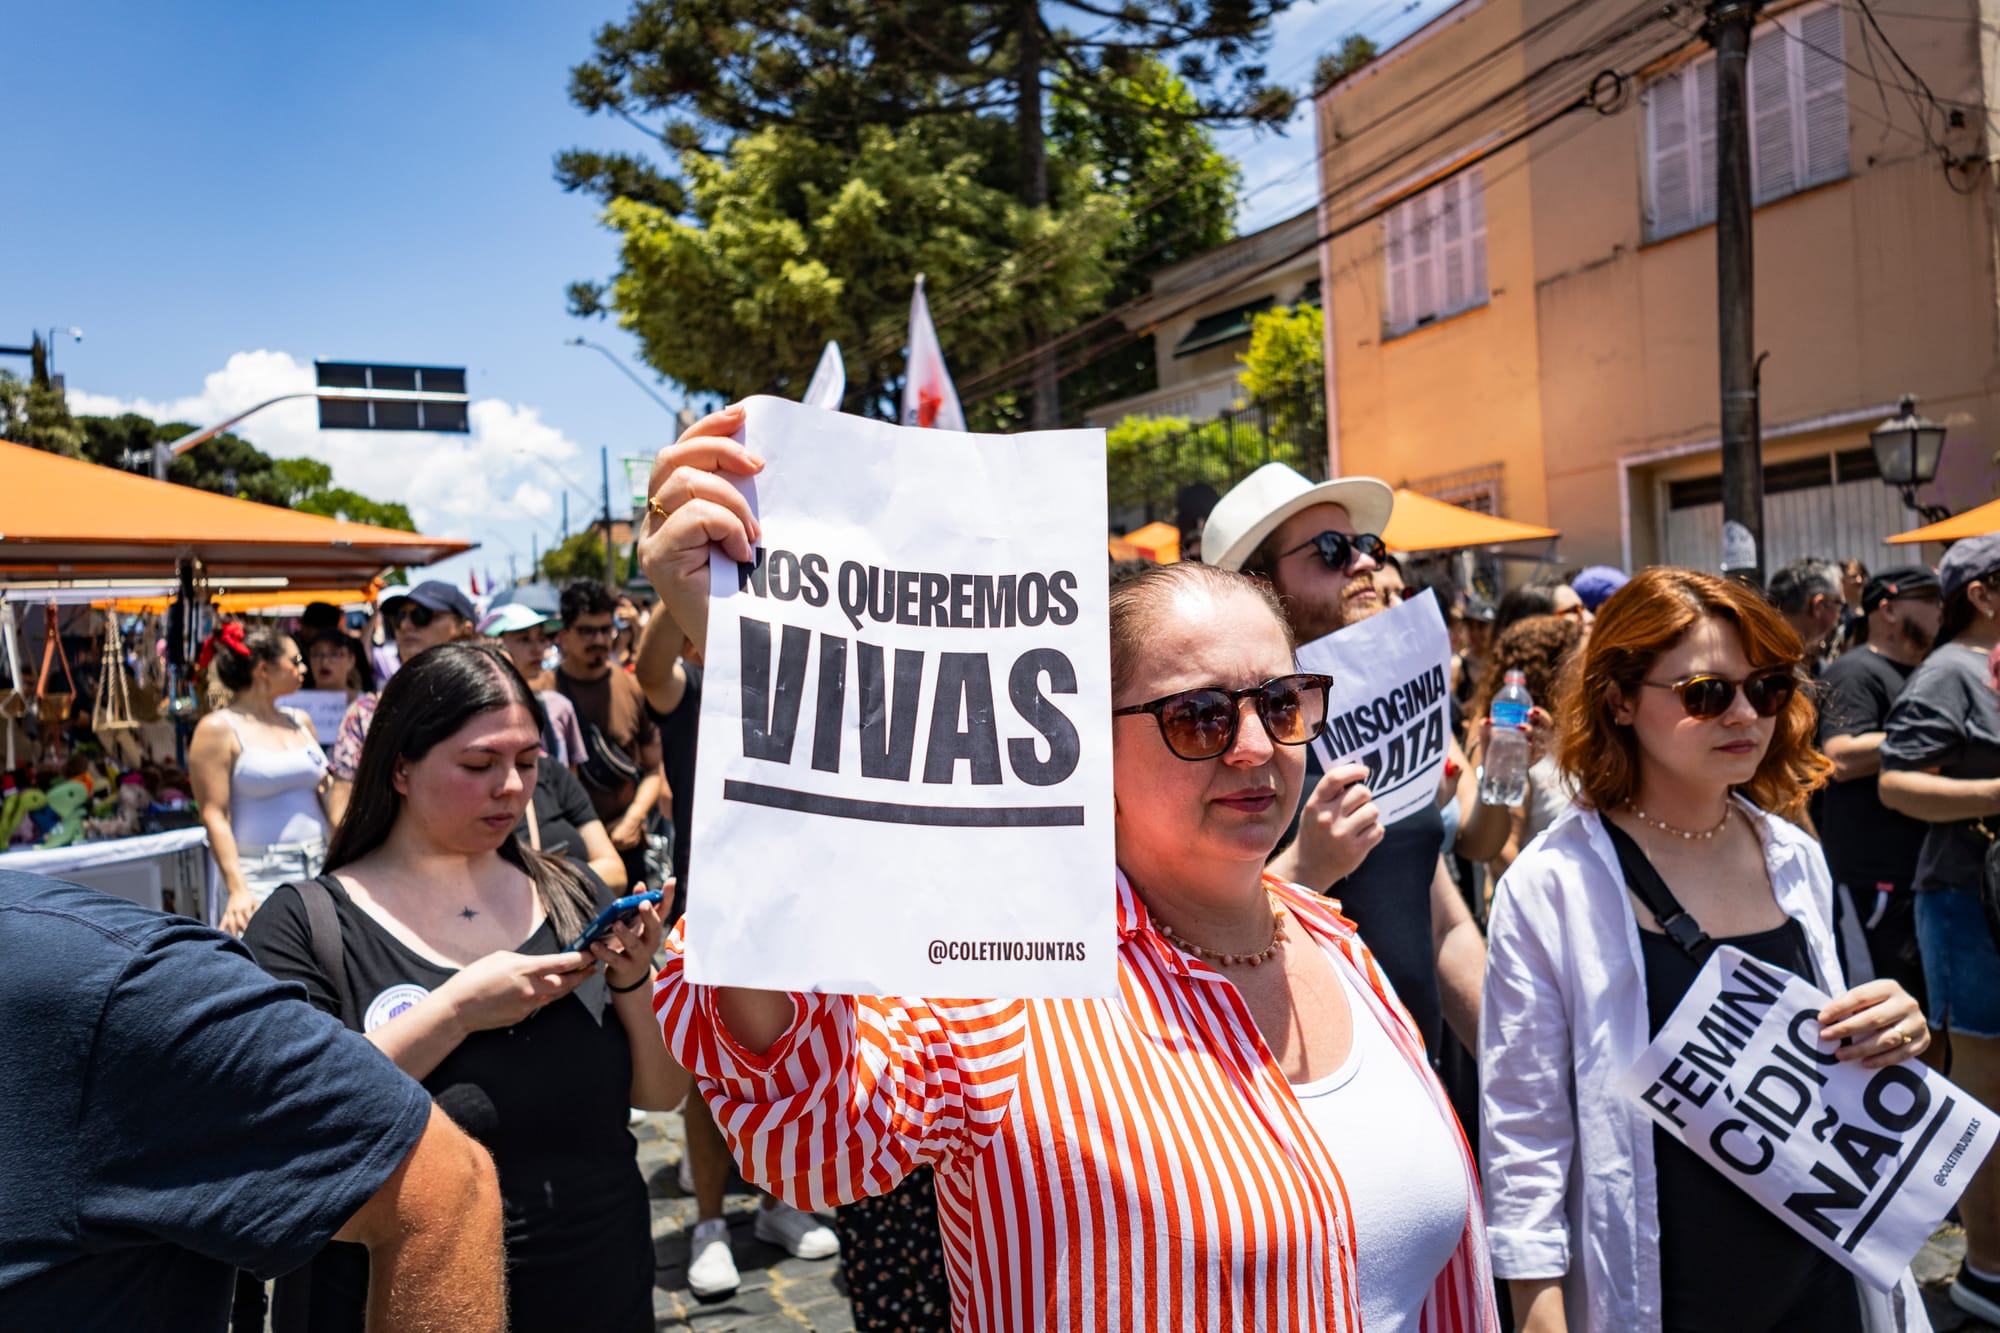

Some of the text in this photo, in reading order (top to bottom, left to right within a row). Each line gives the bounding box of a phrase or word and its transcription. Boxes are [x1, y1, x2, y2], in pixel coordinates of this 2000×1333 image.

[737, 547, 1079, 631] NOS QUEREMOS
[739, 616, 1080, 786] VIVAS
[1312, 664, 1446, 762] MISOGINIA
[928, 941, 1086, 965] @COLETIVOJUNTAS
[1640, 958, 1788, 1130] FEMINI
[1709, 1008, 1853, 1176] CÍDIO
[1782, 1065, 1932, 1242] NÃO
[1933, 1117, 1982, 1187] @COLETIVOJUNTAS
